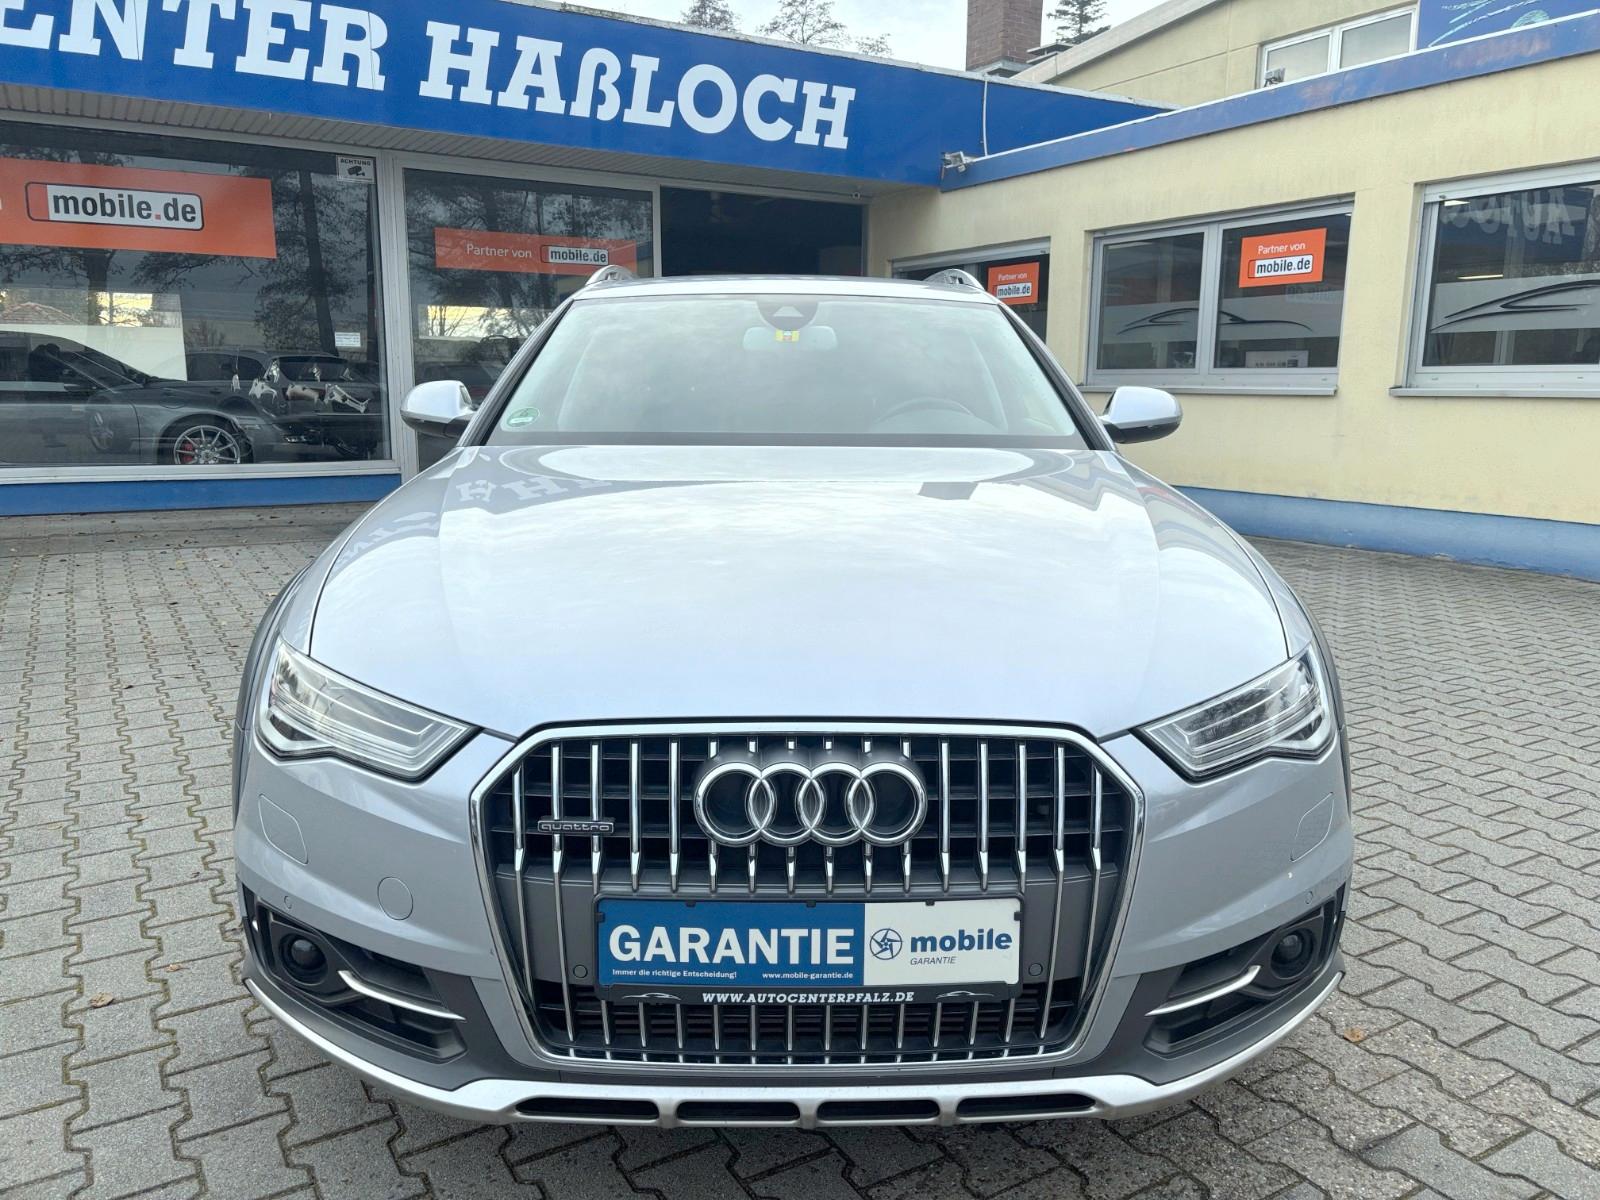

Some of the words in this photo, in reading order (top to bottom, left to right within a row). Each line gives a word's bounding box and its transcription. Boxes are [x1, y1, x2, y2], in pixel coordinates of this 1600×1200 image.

[419, 21, 856, 149] HAßLOCH
[341, 158, 371, 167] ACHTUNG
[53, 193, 197, 223] mobile.de
[466, 243, 508, 257] Partner
[512, 249, 532, 258] von
[550, 249, 607, 263] mobile.de
[1258, 245, 1288, 255] Partner
[1290, 243, 1306, 251] von
[1257, 258, 1311, 274] mobile.de
[997, 284, 1031, 297] mobile.de
[541, 823, 610, 831] quattro
[609, 924, 854, 965] GARANTIE
[911, 928, 1012, 953] mobile
[910, 956, 957, 966] GARANTIE
[652, 969, 681, 978] richtige
[683, 970, 737, 979] Entscheidung!
[762, 971, 854, 980] www.mobile-garantie.de
[702, 991, 915, 1004] WWW.AUTOCENTERPFALZ.DE
